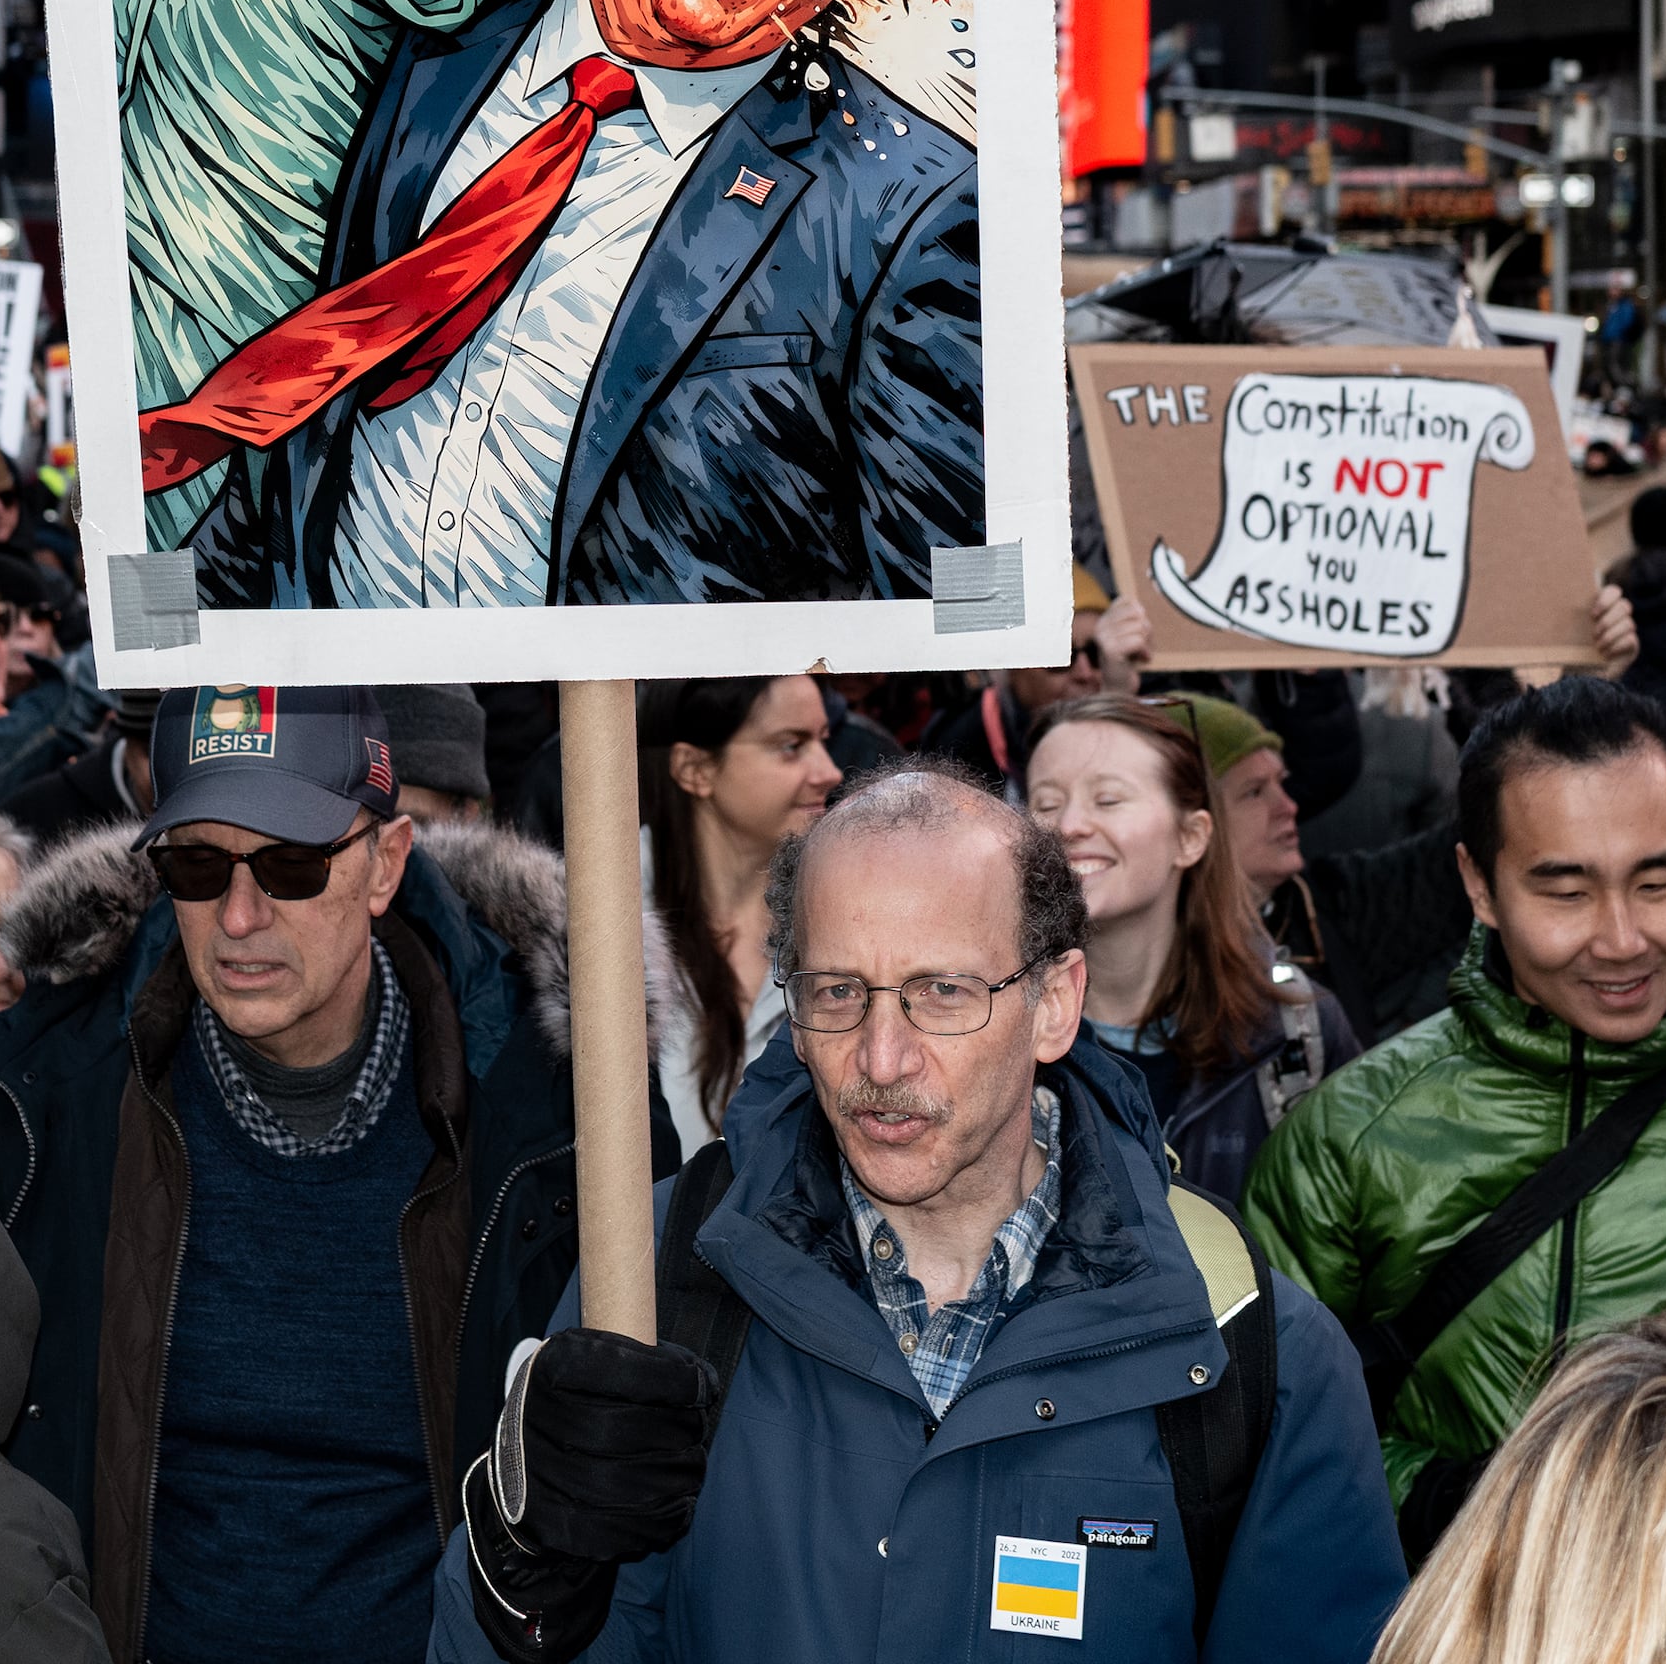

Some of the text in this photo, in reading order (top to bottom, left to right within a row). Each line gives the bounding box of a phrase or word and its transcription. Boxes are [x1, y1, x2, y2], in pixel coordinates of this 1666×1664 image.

[1106, 384, 1470, 443] THE Constitution
[1334, 456, 1445, 501] NOT
[1242, 493, 1448, 559] OPTIONAL
[1307, 551, 1358, 584] YOU
[1225, 574, 1433, 639] ASSHOLES
[195, 733, 268, 757] RESIST
[999, 1542, 1082, 1561] 26.2 NYC 2022
[1087, 1531, 1151, 1547] patagonia
[1010, 1615, 1061, 1633] UKRAINE
